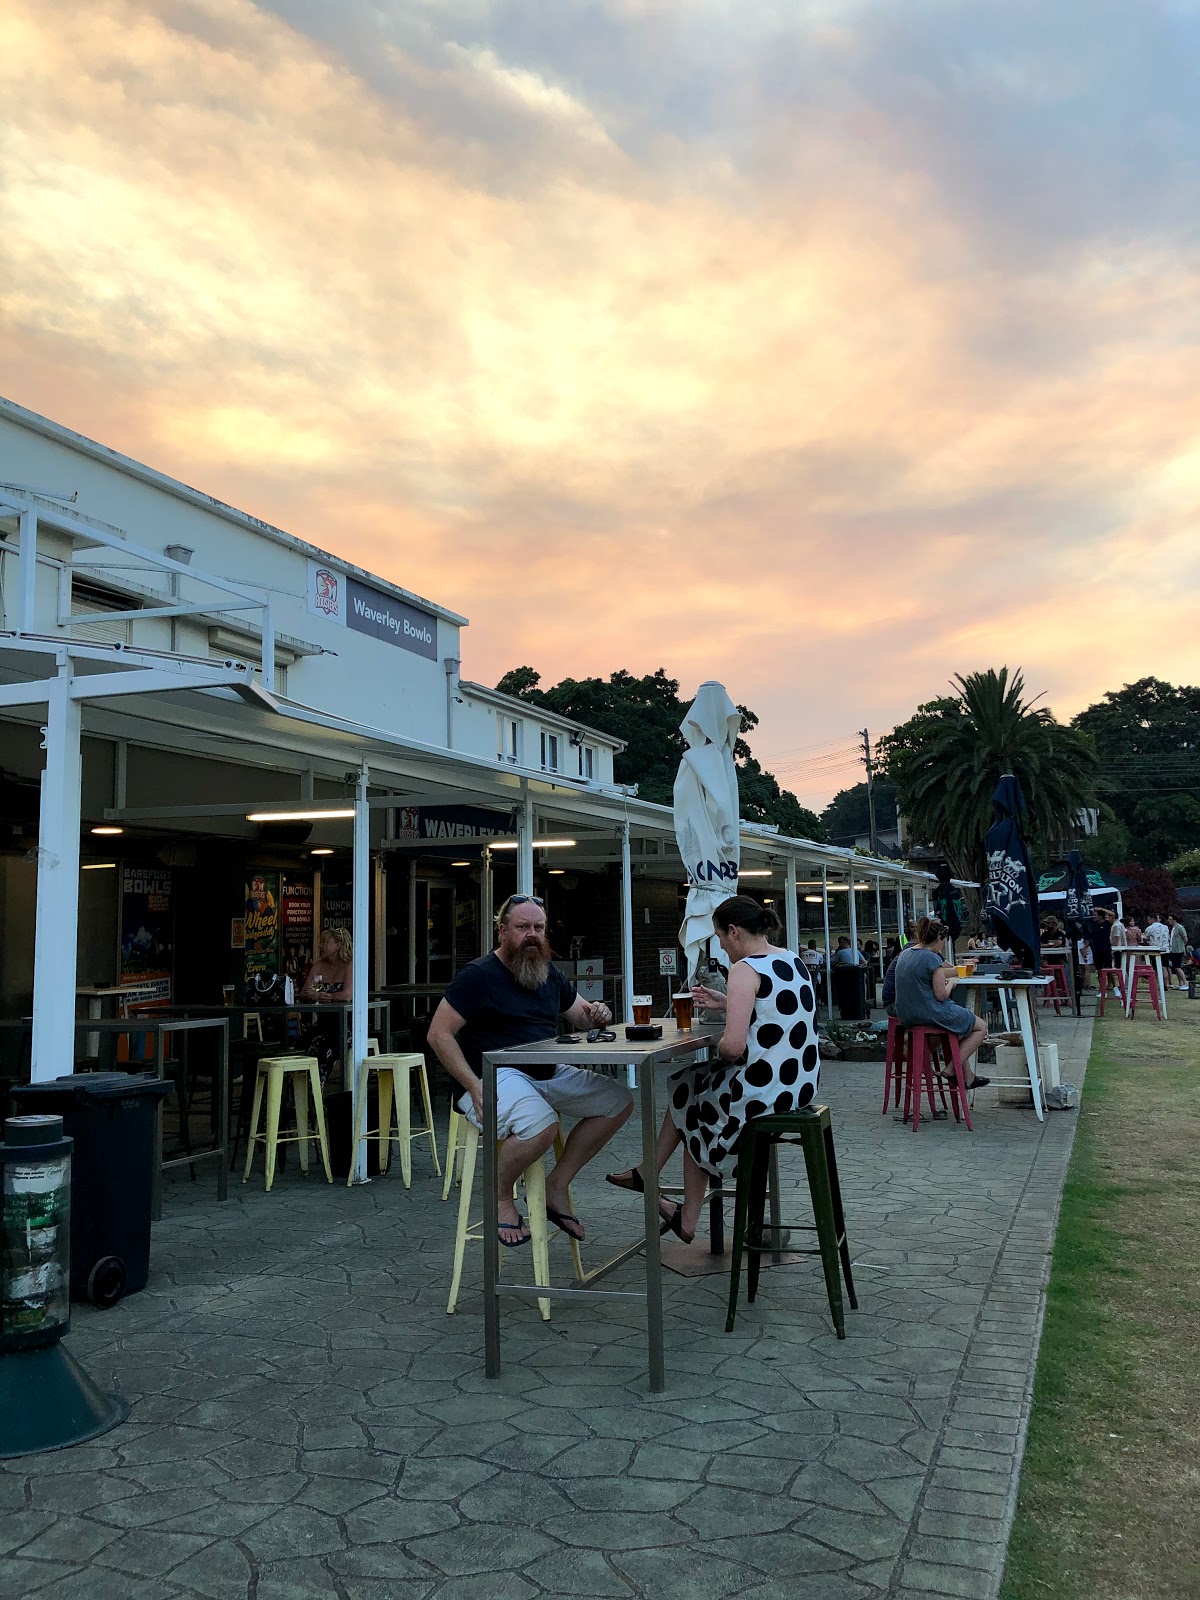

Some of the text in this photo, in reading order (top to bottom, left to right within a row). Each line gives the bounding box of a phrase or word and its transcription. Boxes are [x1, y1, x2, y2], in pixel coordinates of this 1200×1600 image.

[315, 593, 338, 616] ROOSTERS
[353, 597, 432, 645] Waverley Bowlo
[123, 868, 172, 880] BAREFOOT
[123, 879, 172, 895] BOWLS
[326, 900, 352, 911] LUNCH
[324, 917, 353, 929] DINNER
